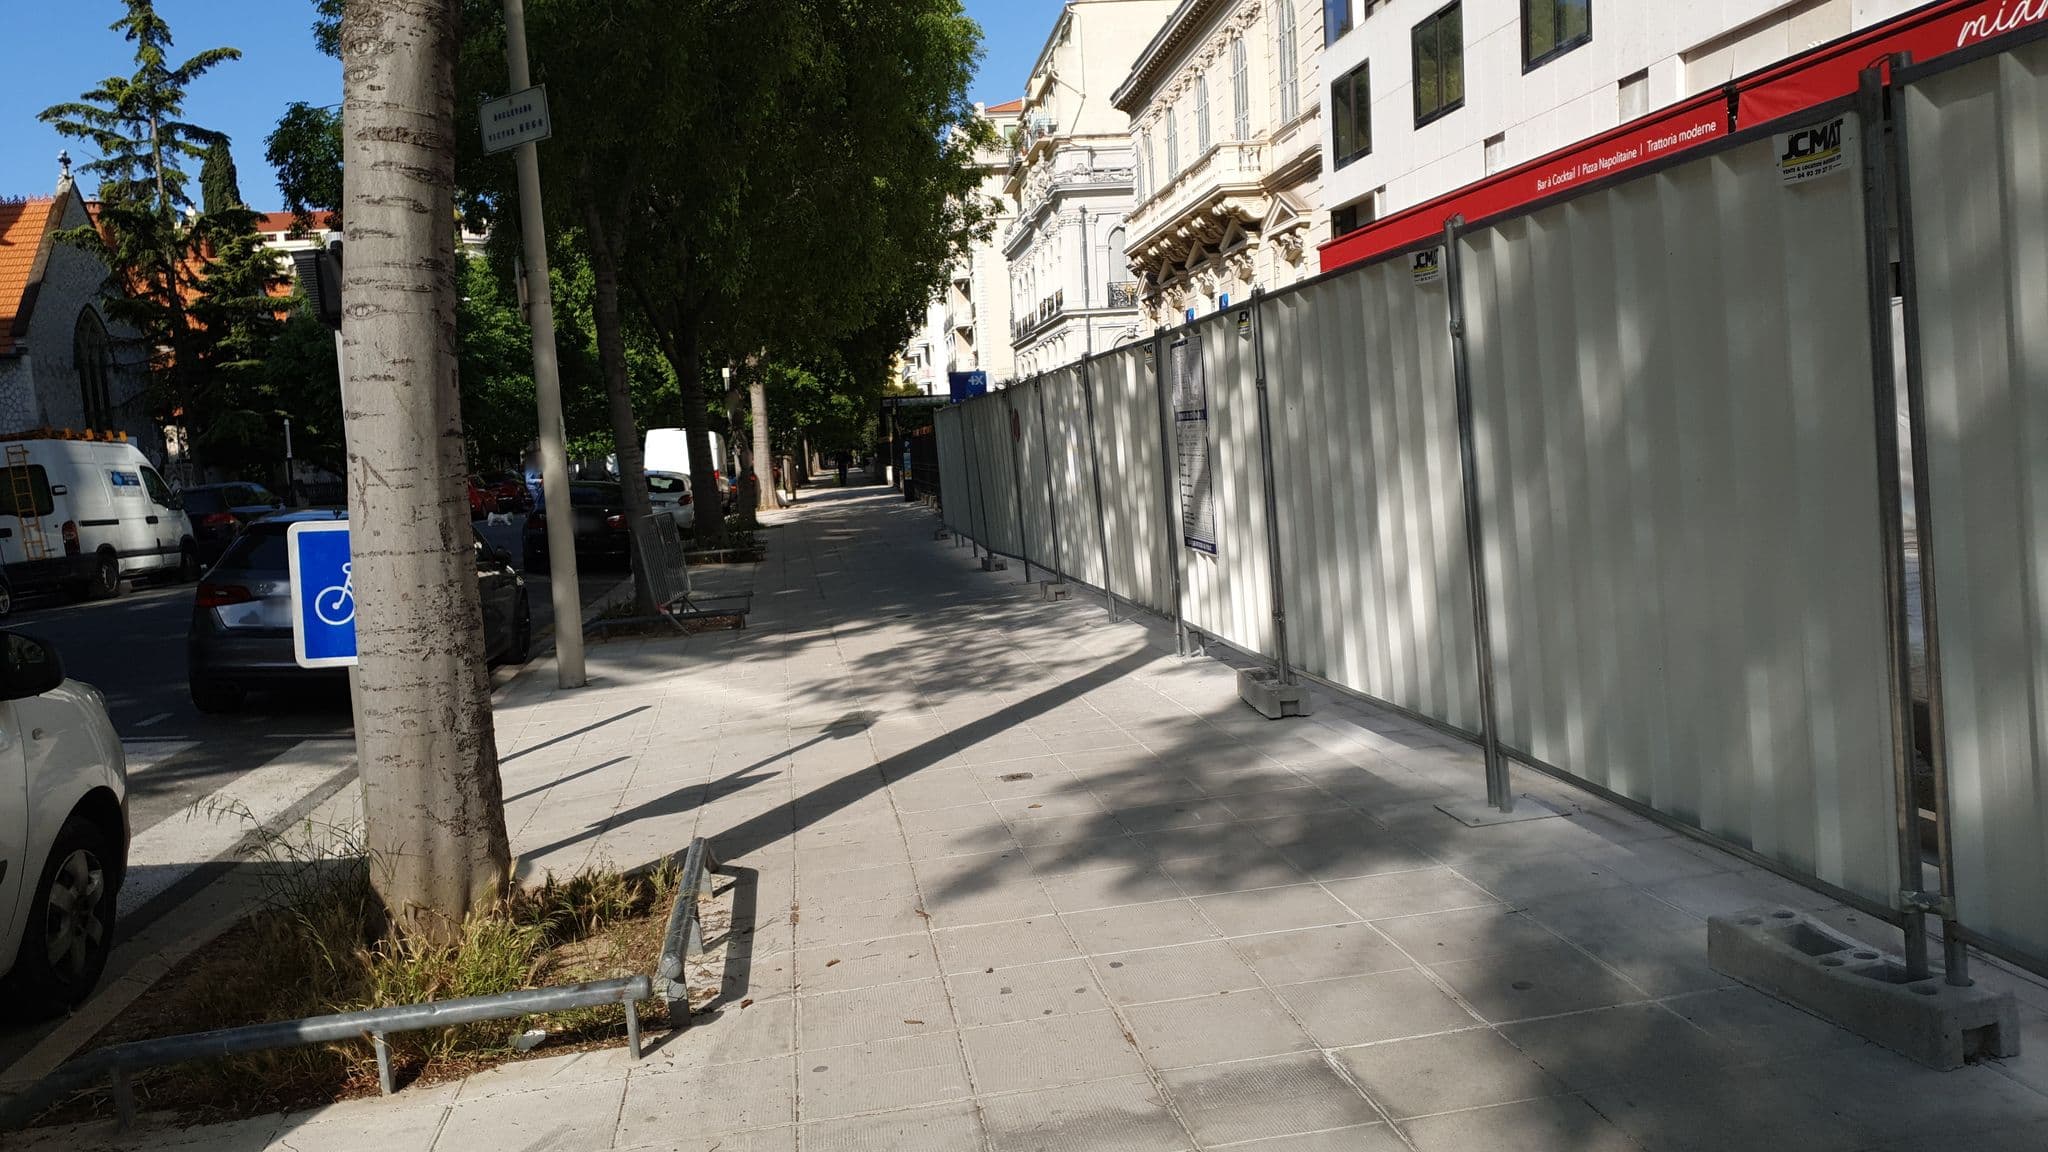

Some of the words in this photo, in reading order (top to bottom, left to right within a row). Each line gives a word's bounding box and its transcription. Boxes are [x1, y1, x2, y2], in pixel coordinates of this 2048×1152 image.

[494, 103, 532, 121] BOULEVARD
[1537, 179, 1547, 191] Bar
[1552, 167, 1576, 186] Cocktail
[1582, 163, 1598, 176] Pizza
[1599, 147, 1638, 171] Napolitaine
[1646, 132, 1678, 153] Trattoria
[1679, 121, 1717, 142] moderne
[1782, 118, 1844, 160] JCMAT
